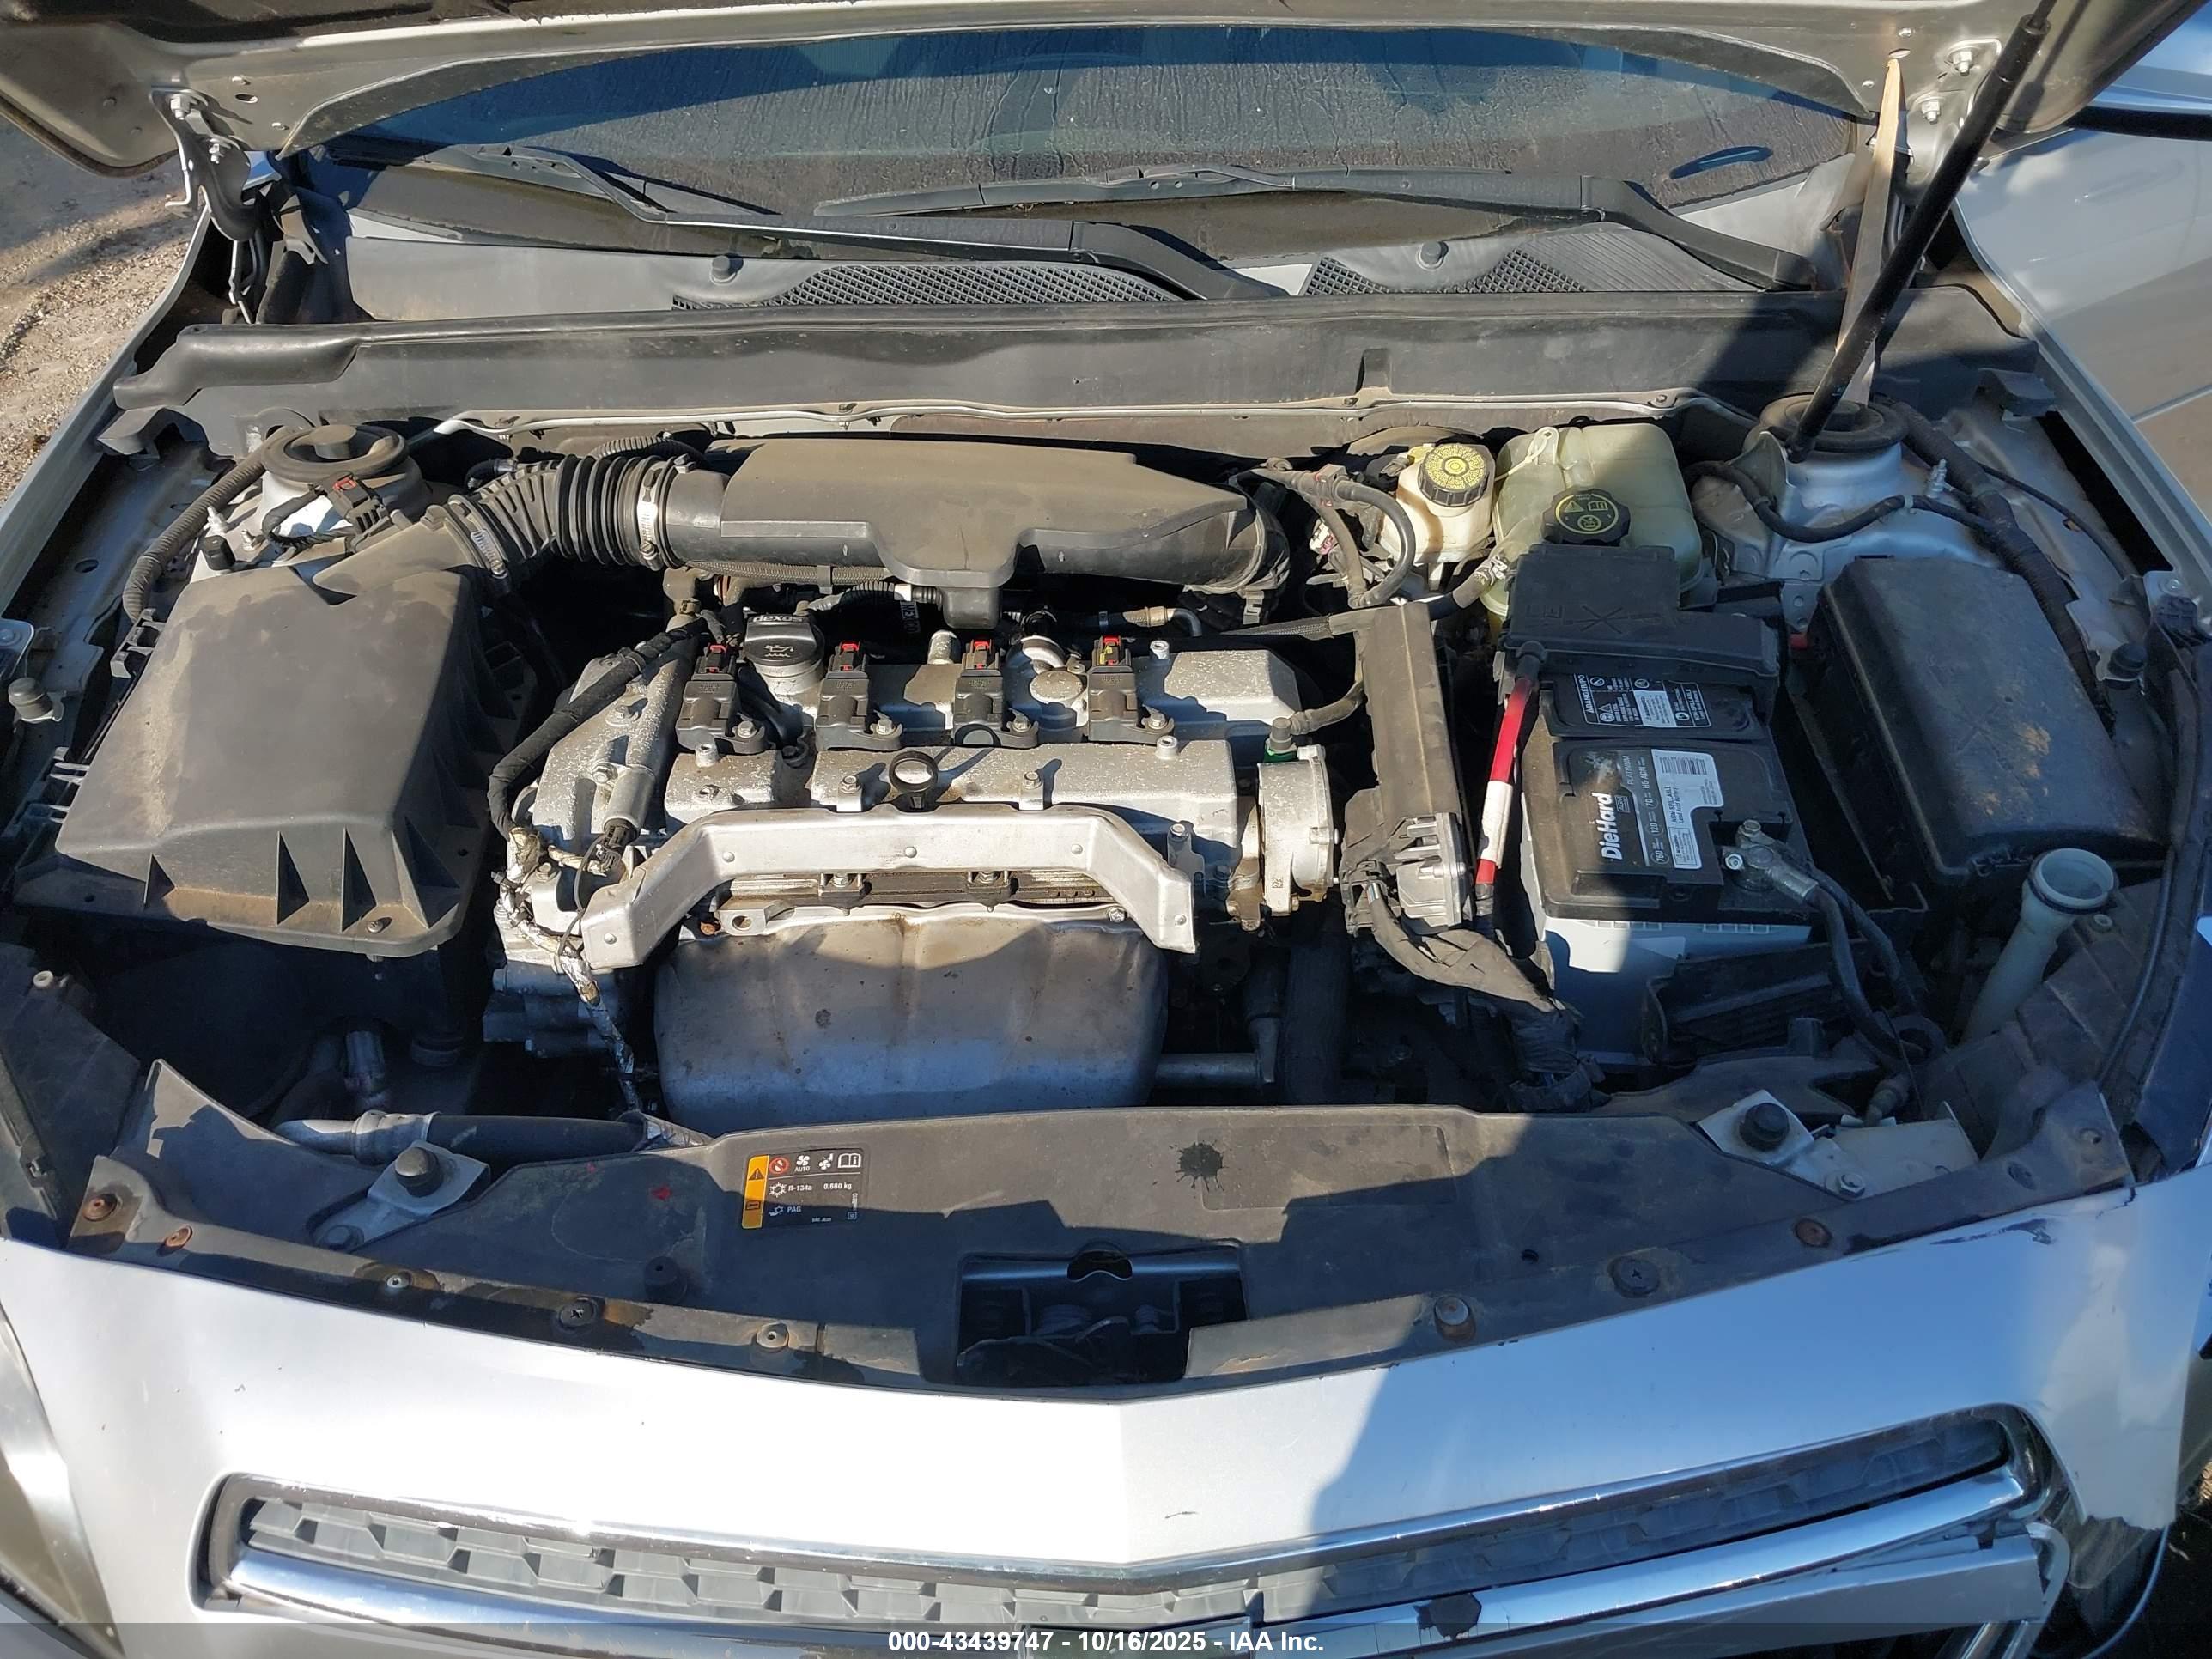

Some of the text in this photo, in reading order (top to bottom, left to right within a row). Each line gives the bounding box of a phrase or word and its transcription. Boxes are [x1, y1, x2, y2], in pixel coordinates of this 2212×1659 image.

[752, 614, 804, 623] dexos
[1685, 688, 1700, 721] NON-SPILLABLE
[1622, 755, 1634, 785] PLATINUM
[1644, 798, 1654, 807] 70
[1664, 786, 1677, 823] NON-SPILLABLE
[1592, 793, 1623, 860] DieHard
[1650, 823, 1660, 834] 120
[1655, 850, 1665, 862] 760
[843, 1182, 853, 1190] kg
